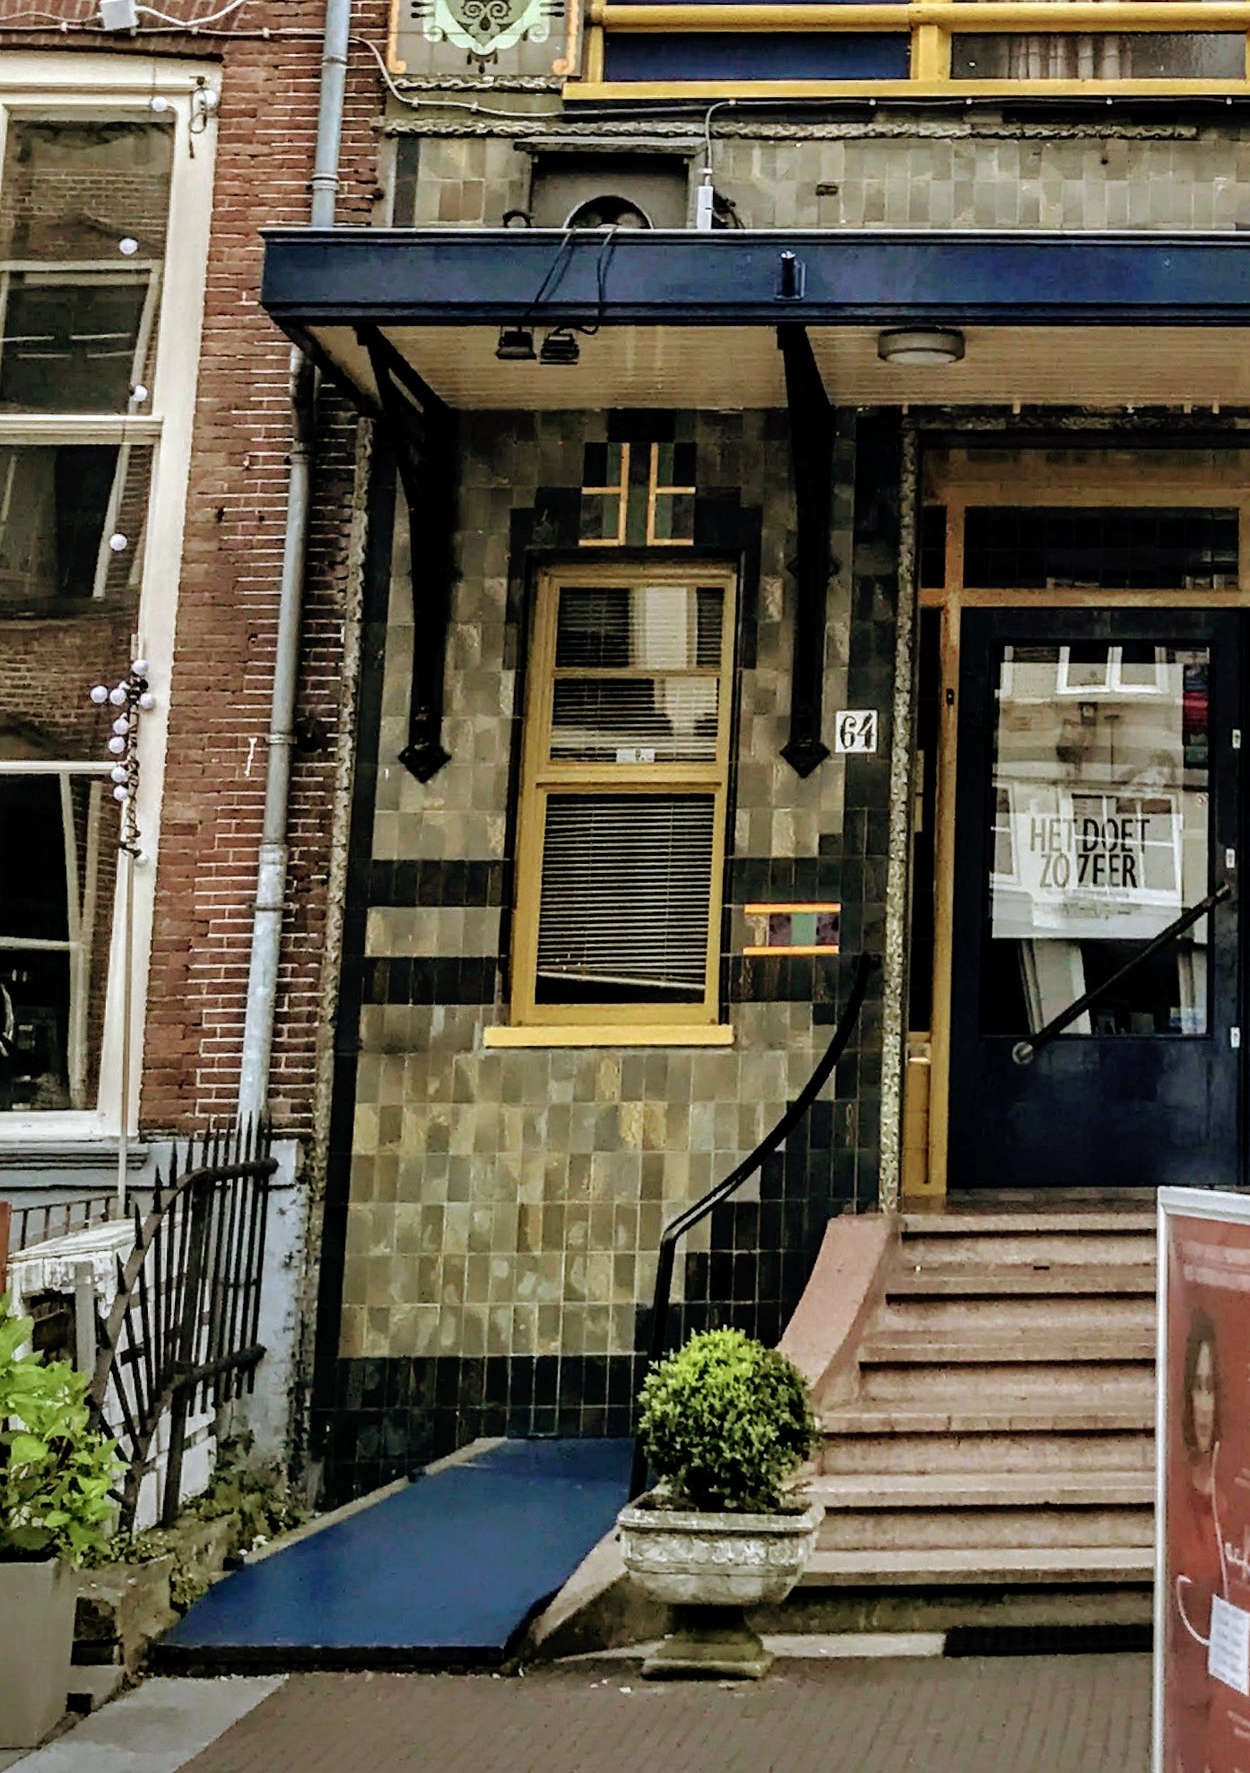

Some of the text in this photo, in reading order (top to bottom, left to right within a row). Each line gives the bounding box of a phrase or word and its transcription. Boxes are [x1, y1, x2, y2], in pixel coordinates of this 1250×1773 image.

[839, 713, 874, 750] 64
[1029, 818, 1150, 853] HET DOET
[1039, 853, 1138, 888] ZO ZEER
